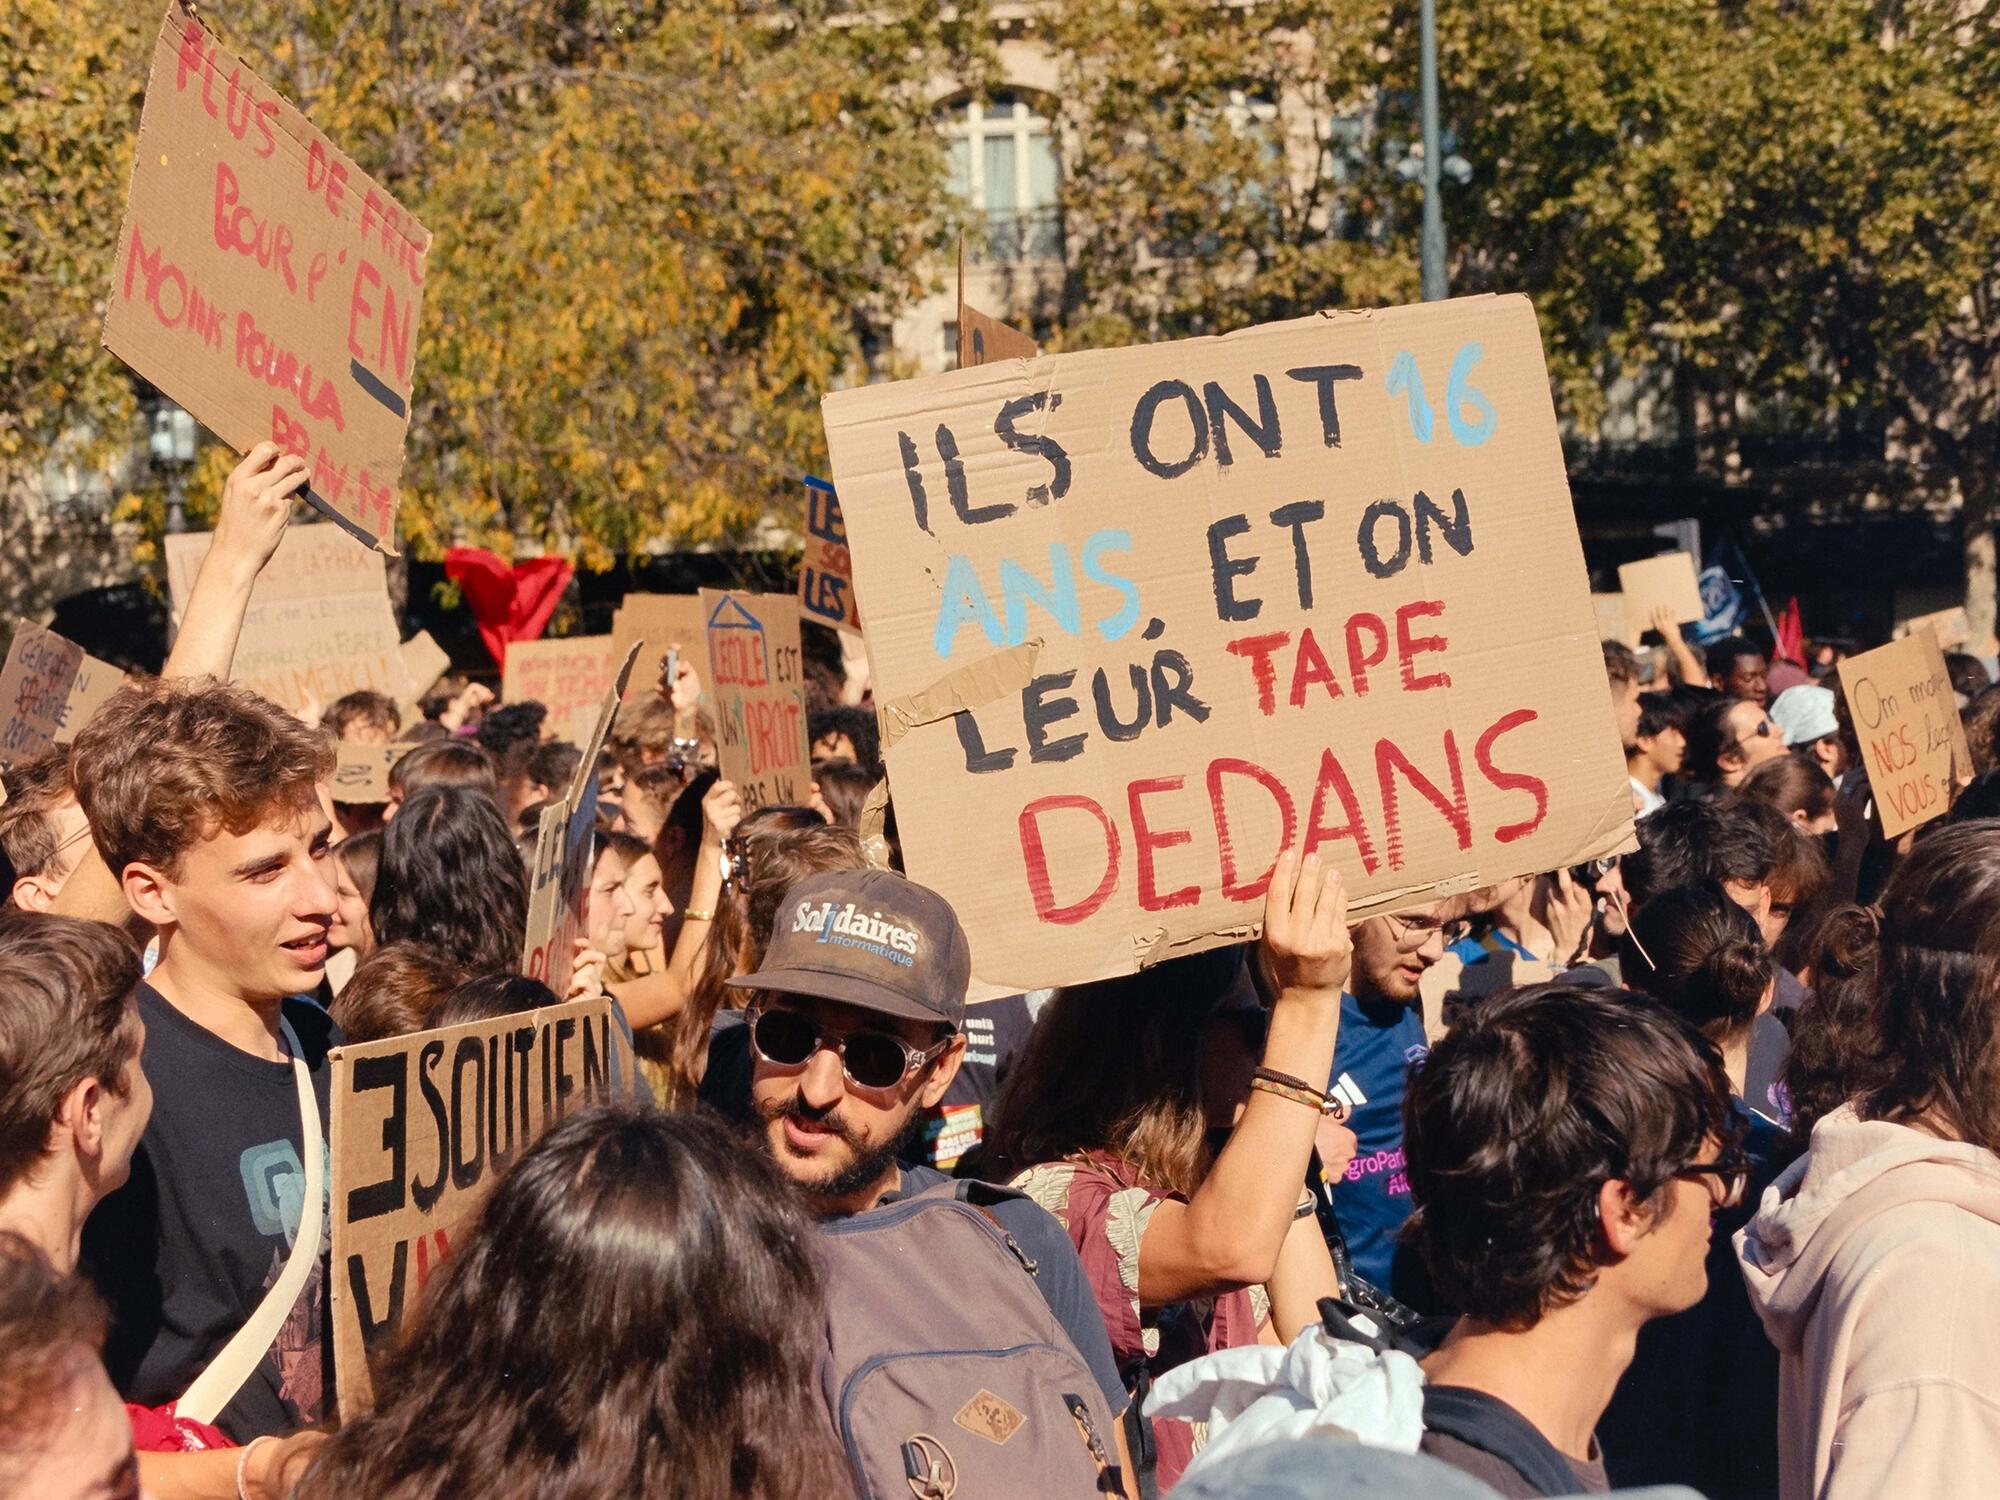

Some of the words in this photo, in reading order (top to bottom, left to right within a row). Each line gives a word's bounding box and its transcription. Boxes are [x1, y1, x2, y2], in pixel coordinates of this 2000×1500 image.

[176, 20, 280, 159] PLUS
[307, 139, 348, 217] DE
[214, 160, 298, 296] POUR
[898, 390, 1072, 537] ILS
[1130, 364, 1364, 479] ONT
[1385, 342, 1497, 447] 16
[1207, 500, 1325, 622] ET
[1357, 488, 1474, 579] ON
[776, 646, 798, 684] EST
[955, 649, 1212, 775] LEUR
[1226, 600, 1452, 716] TAPE
[744, 699, 800, 775] DROIT
[1871, 723, 1918, 779] NOS
[1886, 773, 1938, 821] VOUS
[1018, 708, 1549, 926] DEDANS
[792, 902, 918, 955] Solidaires
[410, 1012, 610, 1215] SOUTIEN
